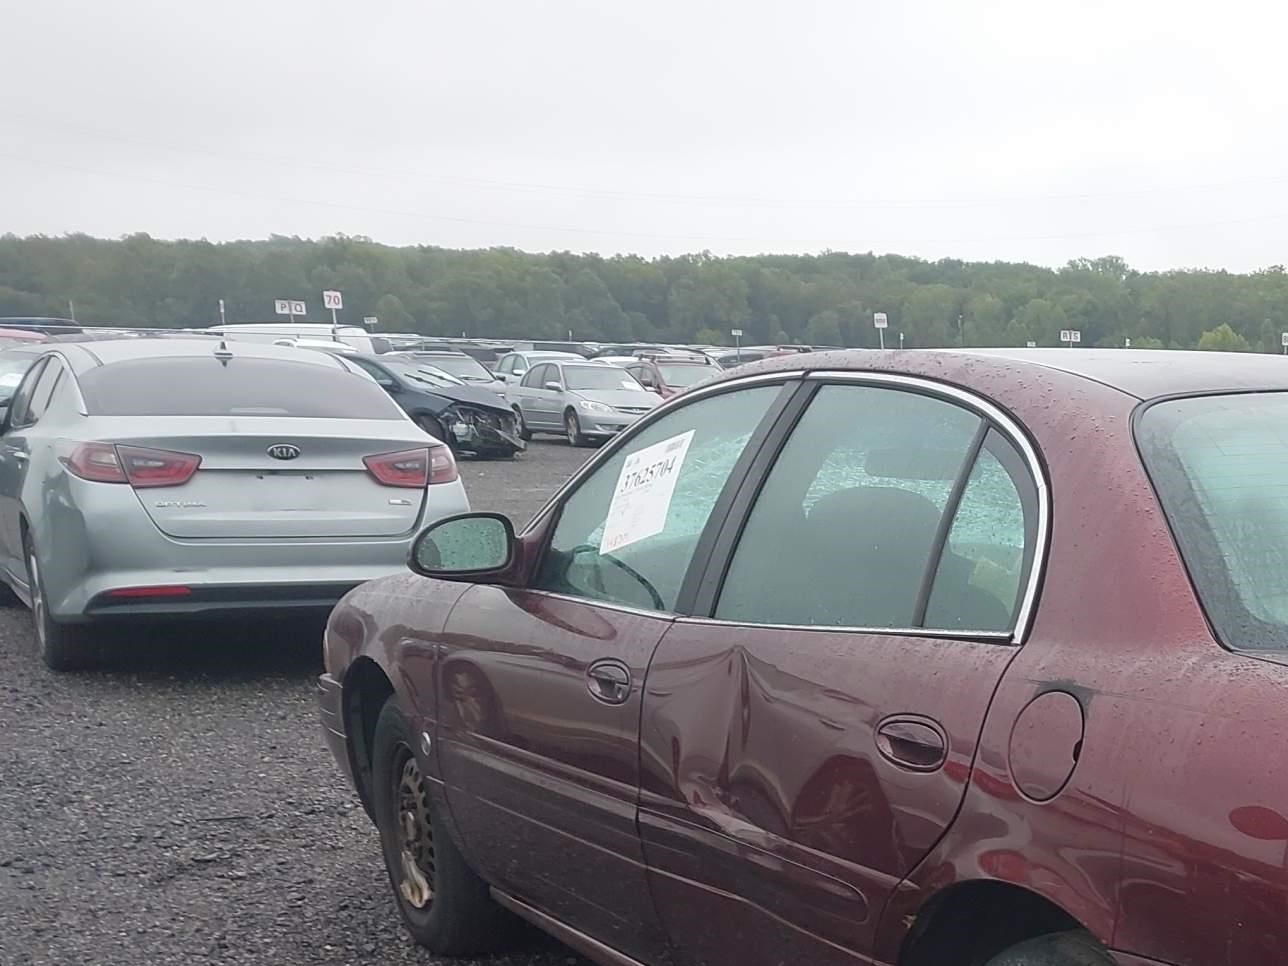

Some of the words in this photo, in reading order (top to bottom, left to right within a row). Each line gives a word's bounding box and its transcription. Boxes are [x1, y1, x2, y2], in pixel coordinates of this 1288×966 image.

[325, 294, 340, 305] 70
[280, 304, 287, 312] P
[294, 303, 303, 313] Q
